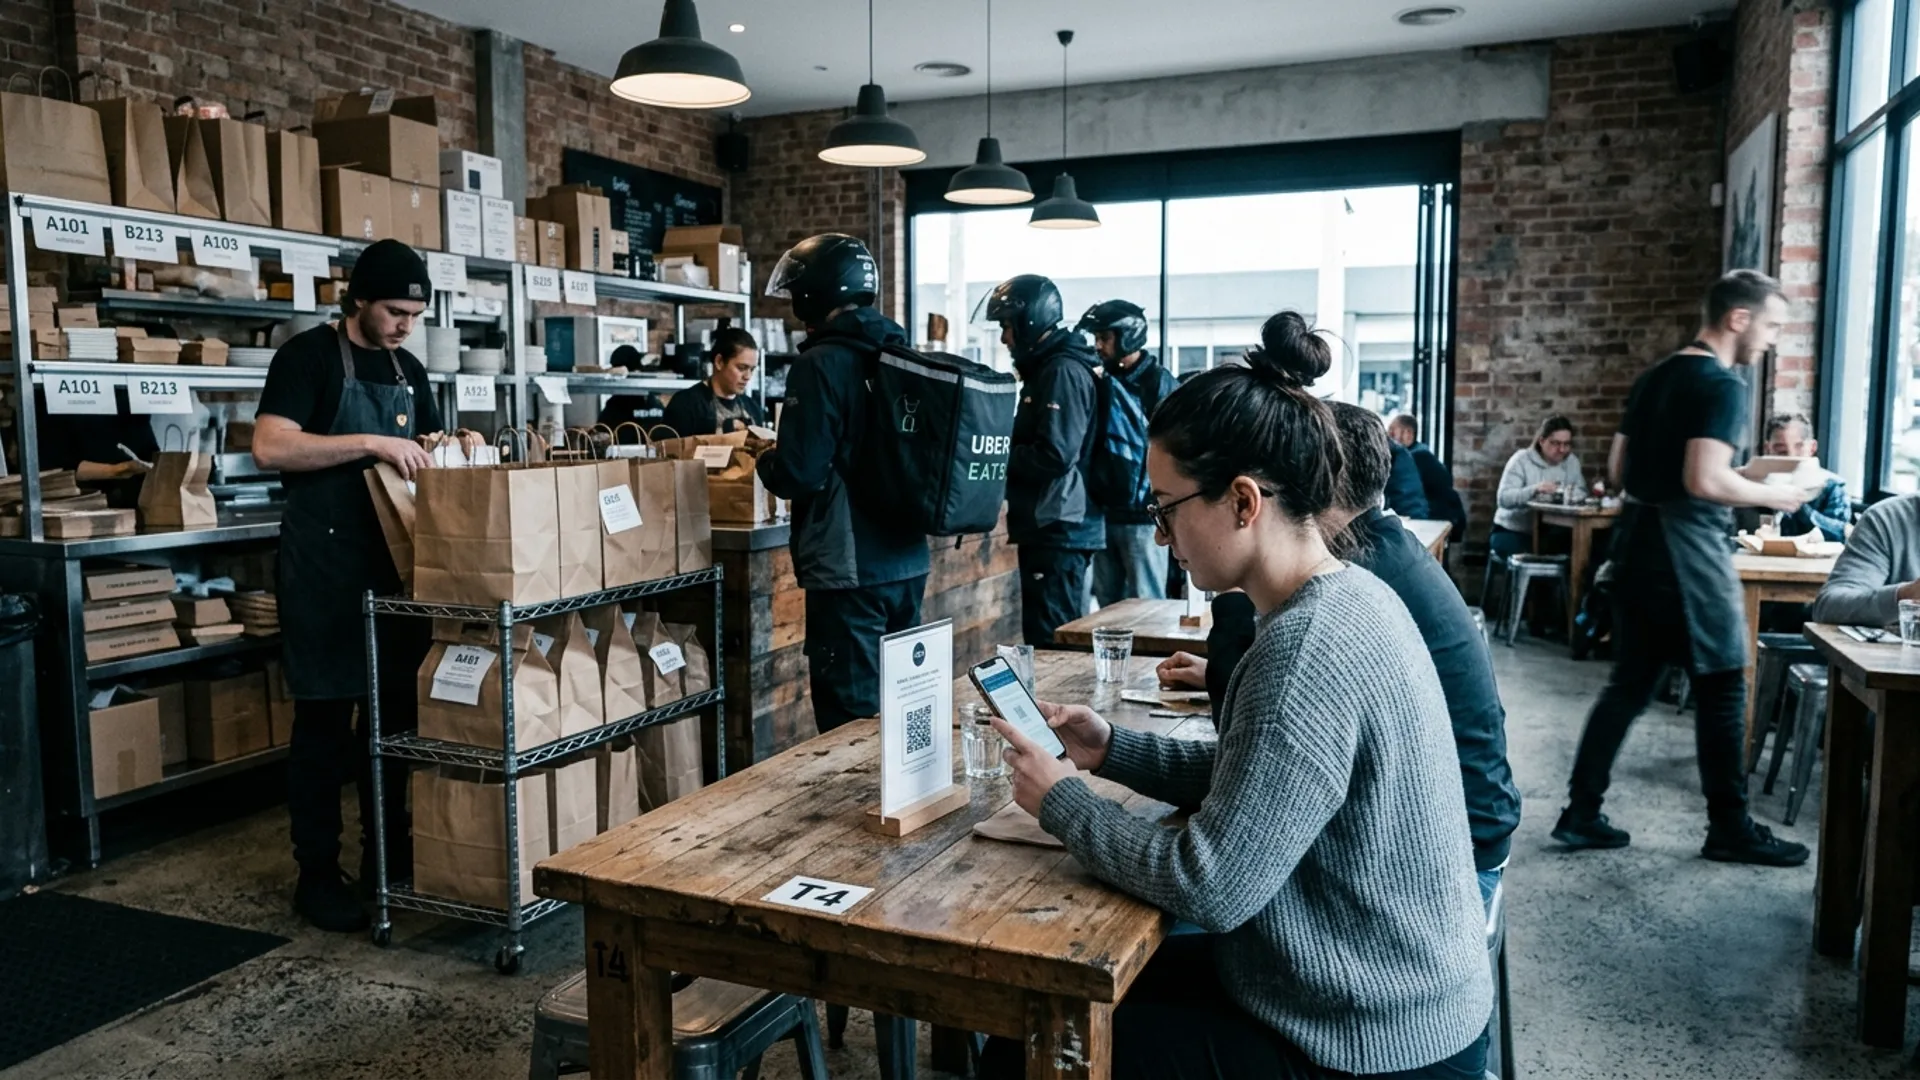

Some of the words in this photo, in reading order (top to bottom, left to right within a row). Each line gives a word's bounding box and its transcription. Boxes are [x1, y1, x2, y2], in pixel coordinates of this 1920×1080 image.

[46, 215, 89, 235] A101
[124, 225, 164, 243] B213
[203, 235, 239, 251] A103
[58, 379, 101, 394] A101
[140, 381, 178, 395] B213
[971, 435, 1010, 455] UBER
[968, 462, 1006, 480] EATS
[790, 882, 850, 907] T4
